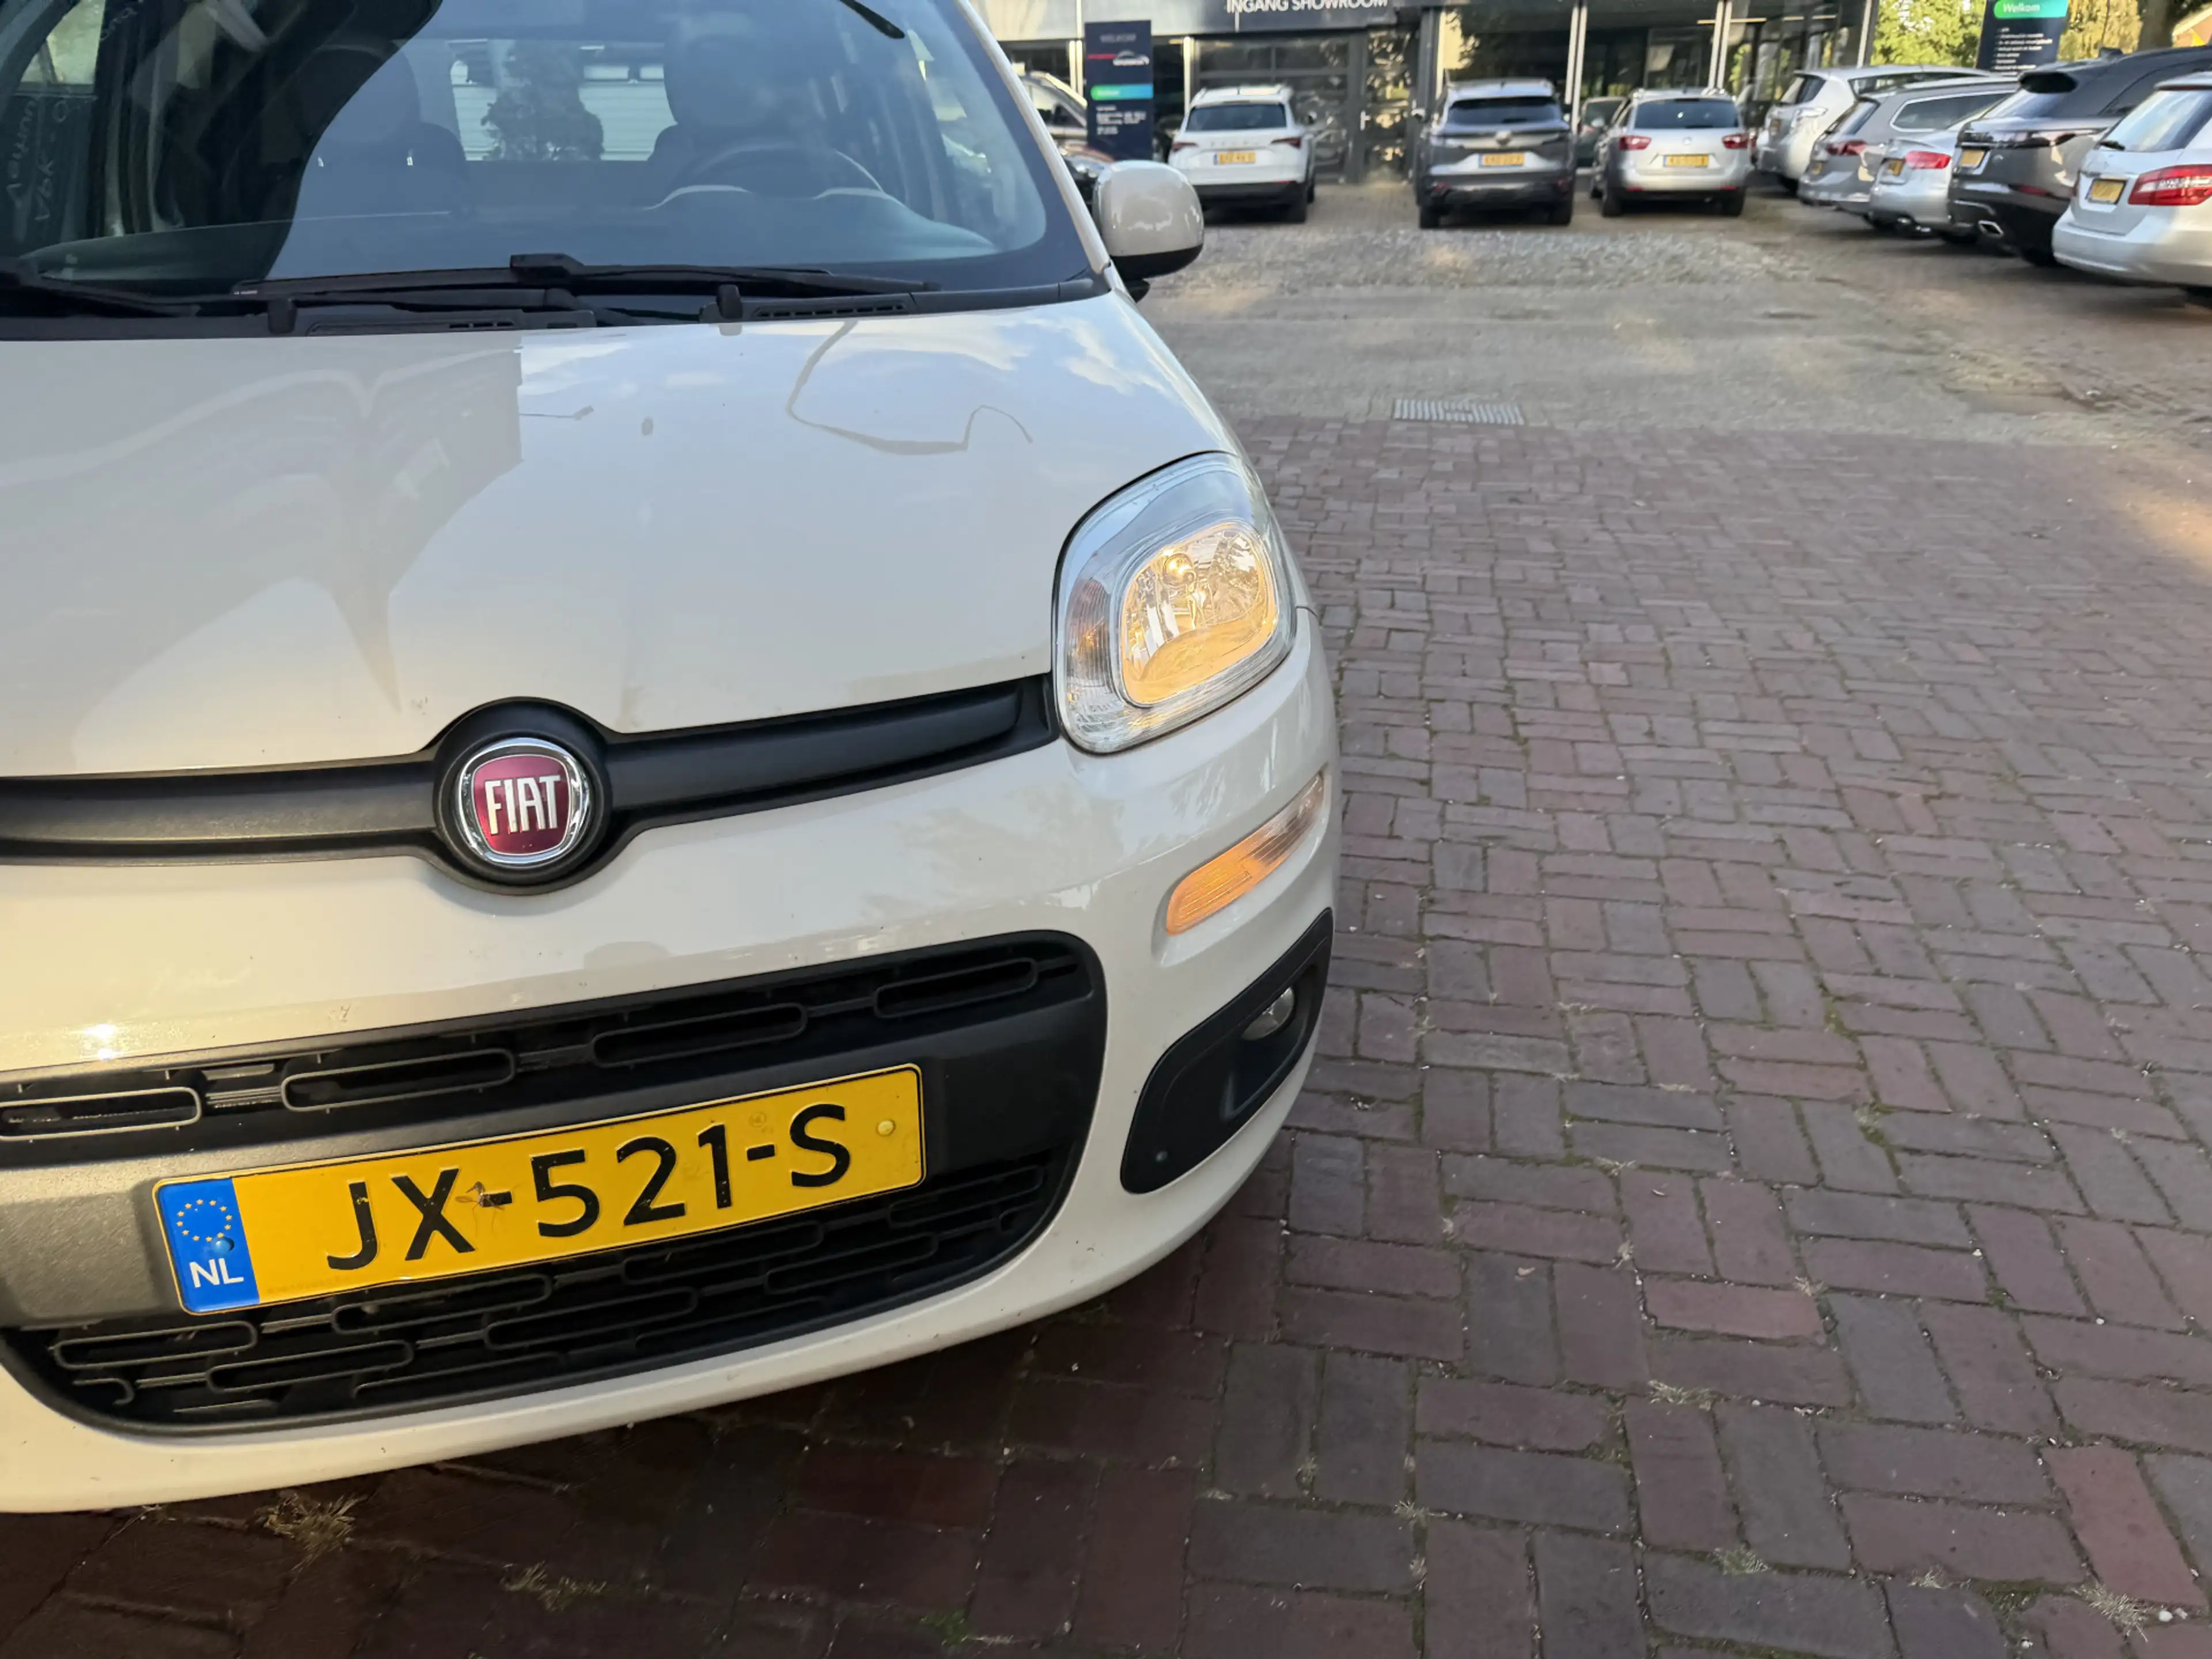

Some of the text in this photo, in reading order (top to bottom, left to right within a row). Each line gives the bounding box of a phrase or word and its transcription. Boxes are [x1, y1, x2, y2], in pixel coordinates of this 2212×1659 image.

[1227, 0, 1289, 13] INGANG
[484, 775, 562, 835] FIAT
[327, 1104, 851, 1270] JX-521-S
[189, 1258, 244, 1288] NL
